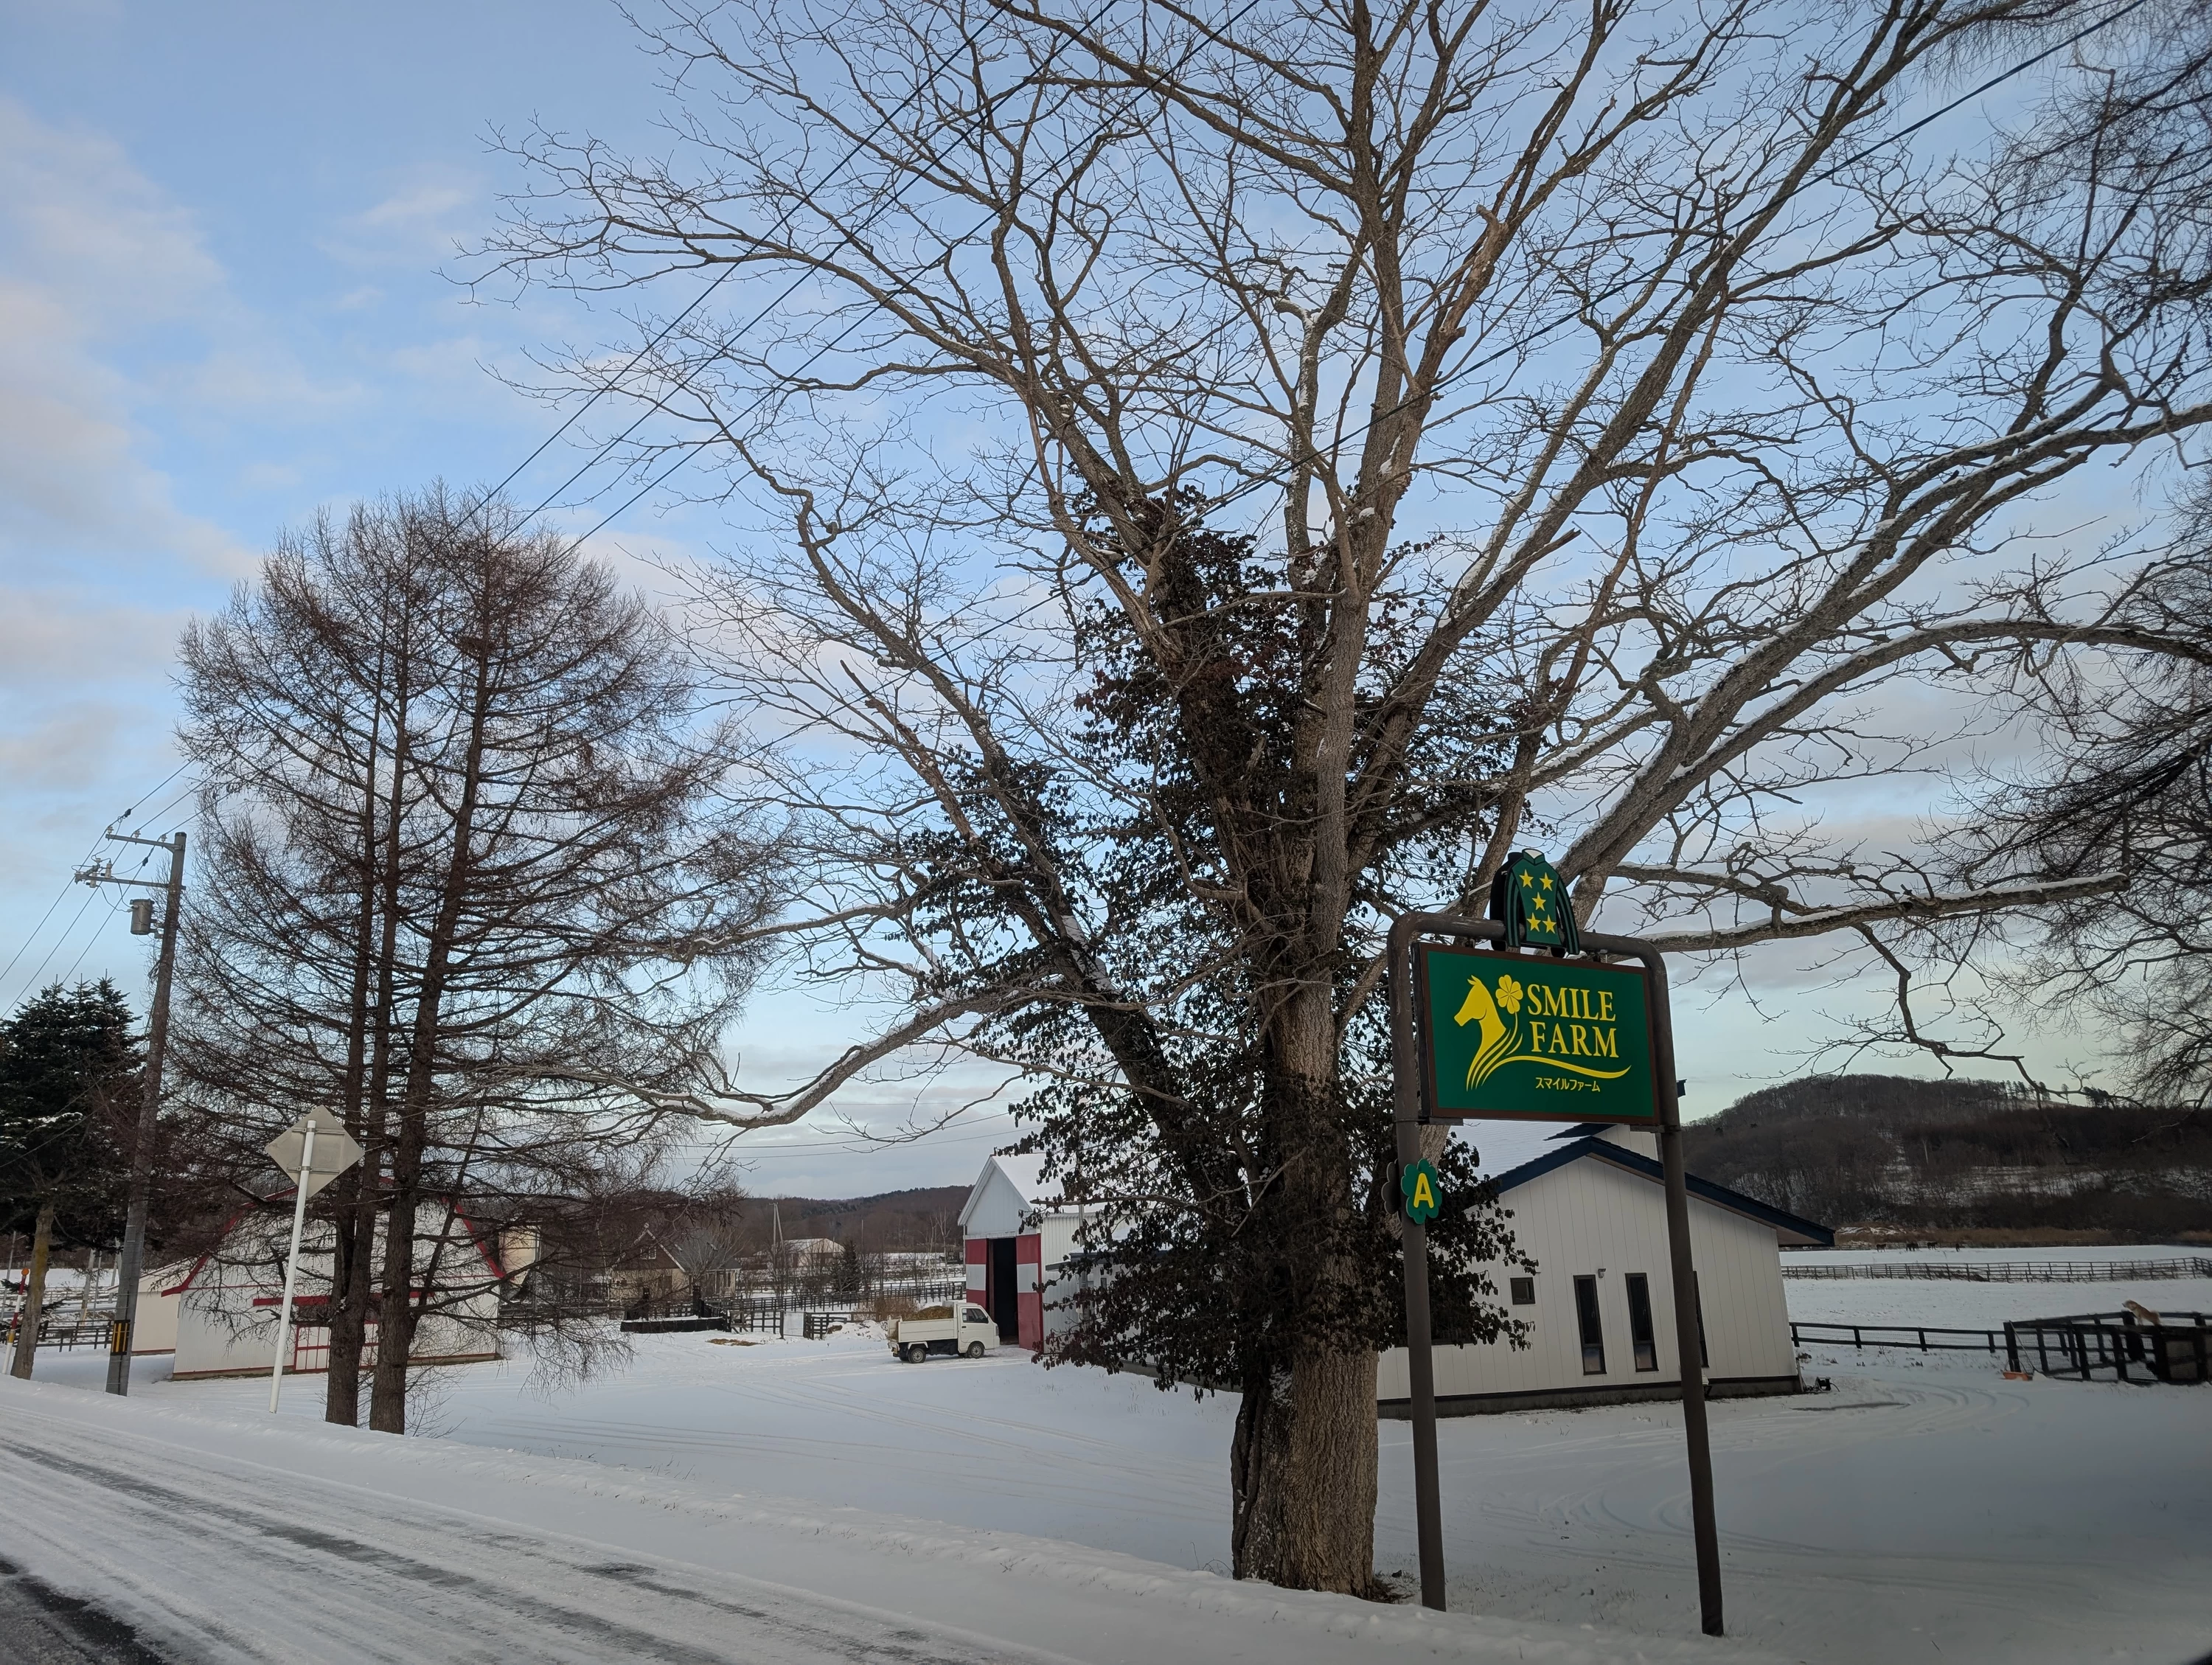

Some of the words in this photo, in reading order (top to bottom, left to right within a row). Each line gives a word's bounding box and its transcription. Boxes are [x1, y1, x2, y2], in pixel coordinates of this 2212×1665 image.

[1527, 984, 1615, 1021] SMILE
[1529, 1021, 1618, 1057] FARM
[1535, 1077, 1601, 1092] スマイルファーム
[1413, 1172, 1434, 1209] A
